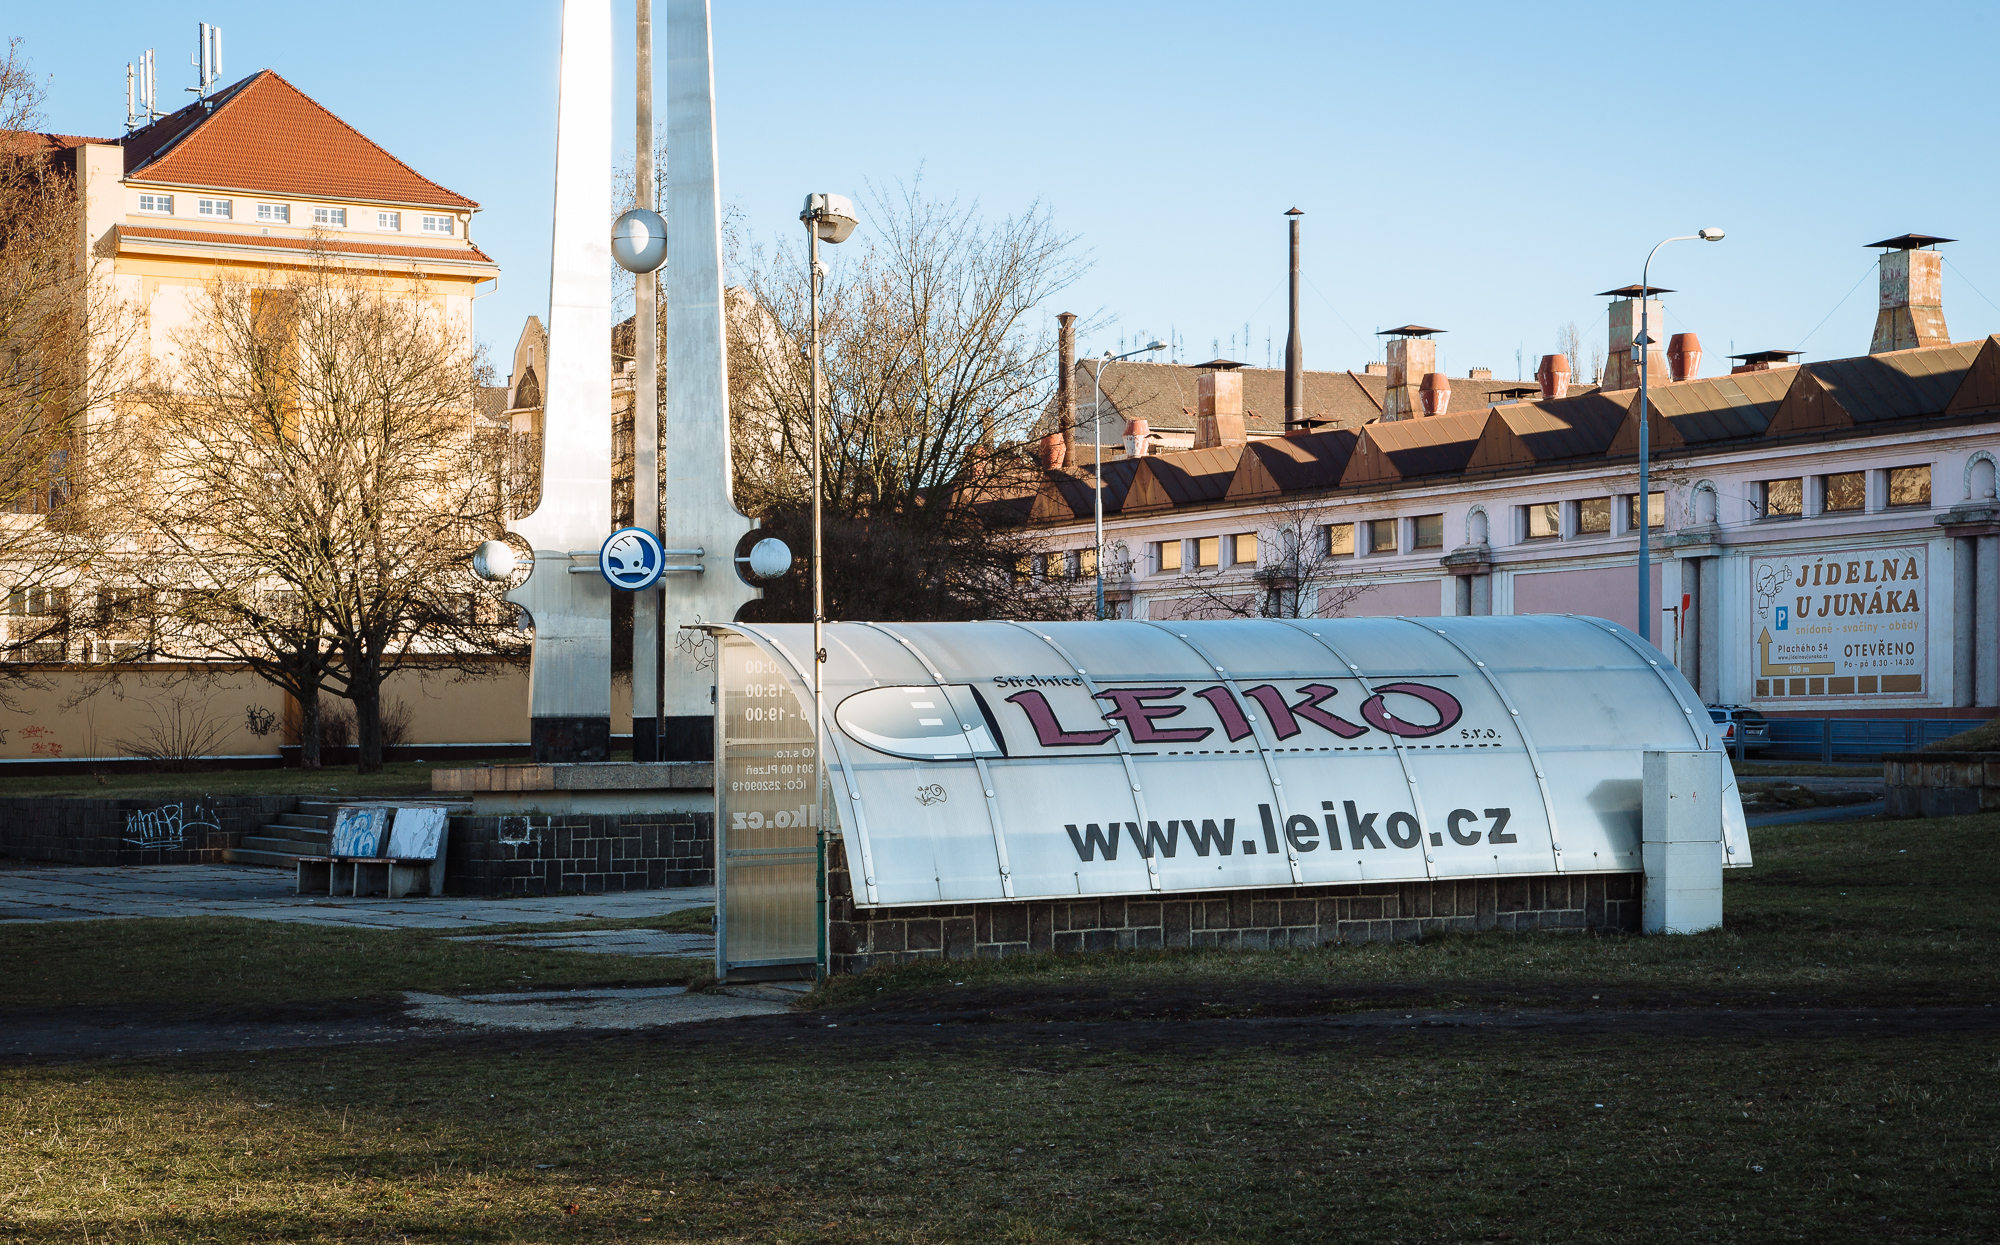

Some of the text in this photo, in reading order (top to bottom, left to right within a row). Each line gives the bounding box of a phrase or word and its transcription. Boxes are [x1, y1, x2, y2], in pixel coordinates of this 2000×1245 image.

[1795, 557, 1919, 588] JÍDELNA
[1796, 585, 1920, 618] U JUNÁKA
[1778, 609, 1786, 627] P
[1796, 622, 1833, 635] snídaně
[1843, 621, 1878, 634] svačiny
[1888, 619, 1919, 632] obědy
[1778, 643, 1828, 653] Plachého 54
[1844, 639, 1915, 658] OTEVŘENO
[1788, 665, 1801, 674] 150
[1844, 660, 1852, 668] Po
[1872, 659, 1887, 667] 8.30
[1895, 658, 1915, 667] 14.30
[993, 674, 1082, 688] Střelnice
[1004, 682, 1502, 746] LEIKO s.r.o.
[1065, 800, 1518, 862] www.leiko.cz
